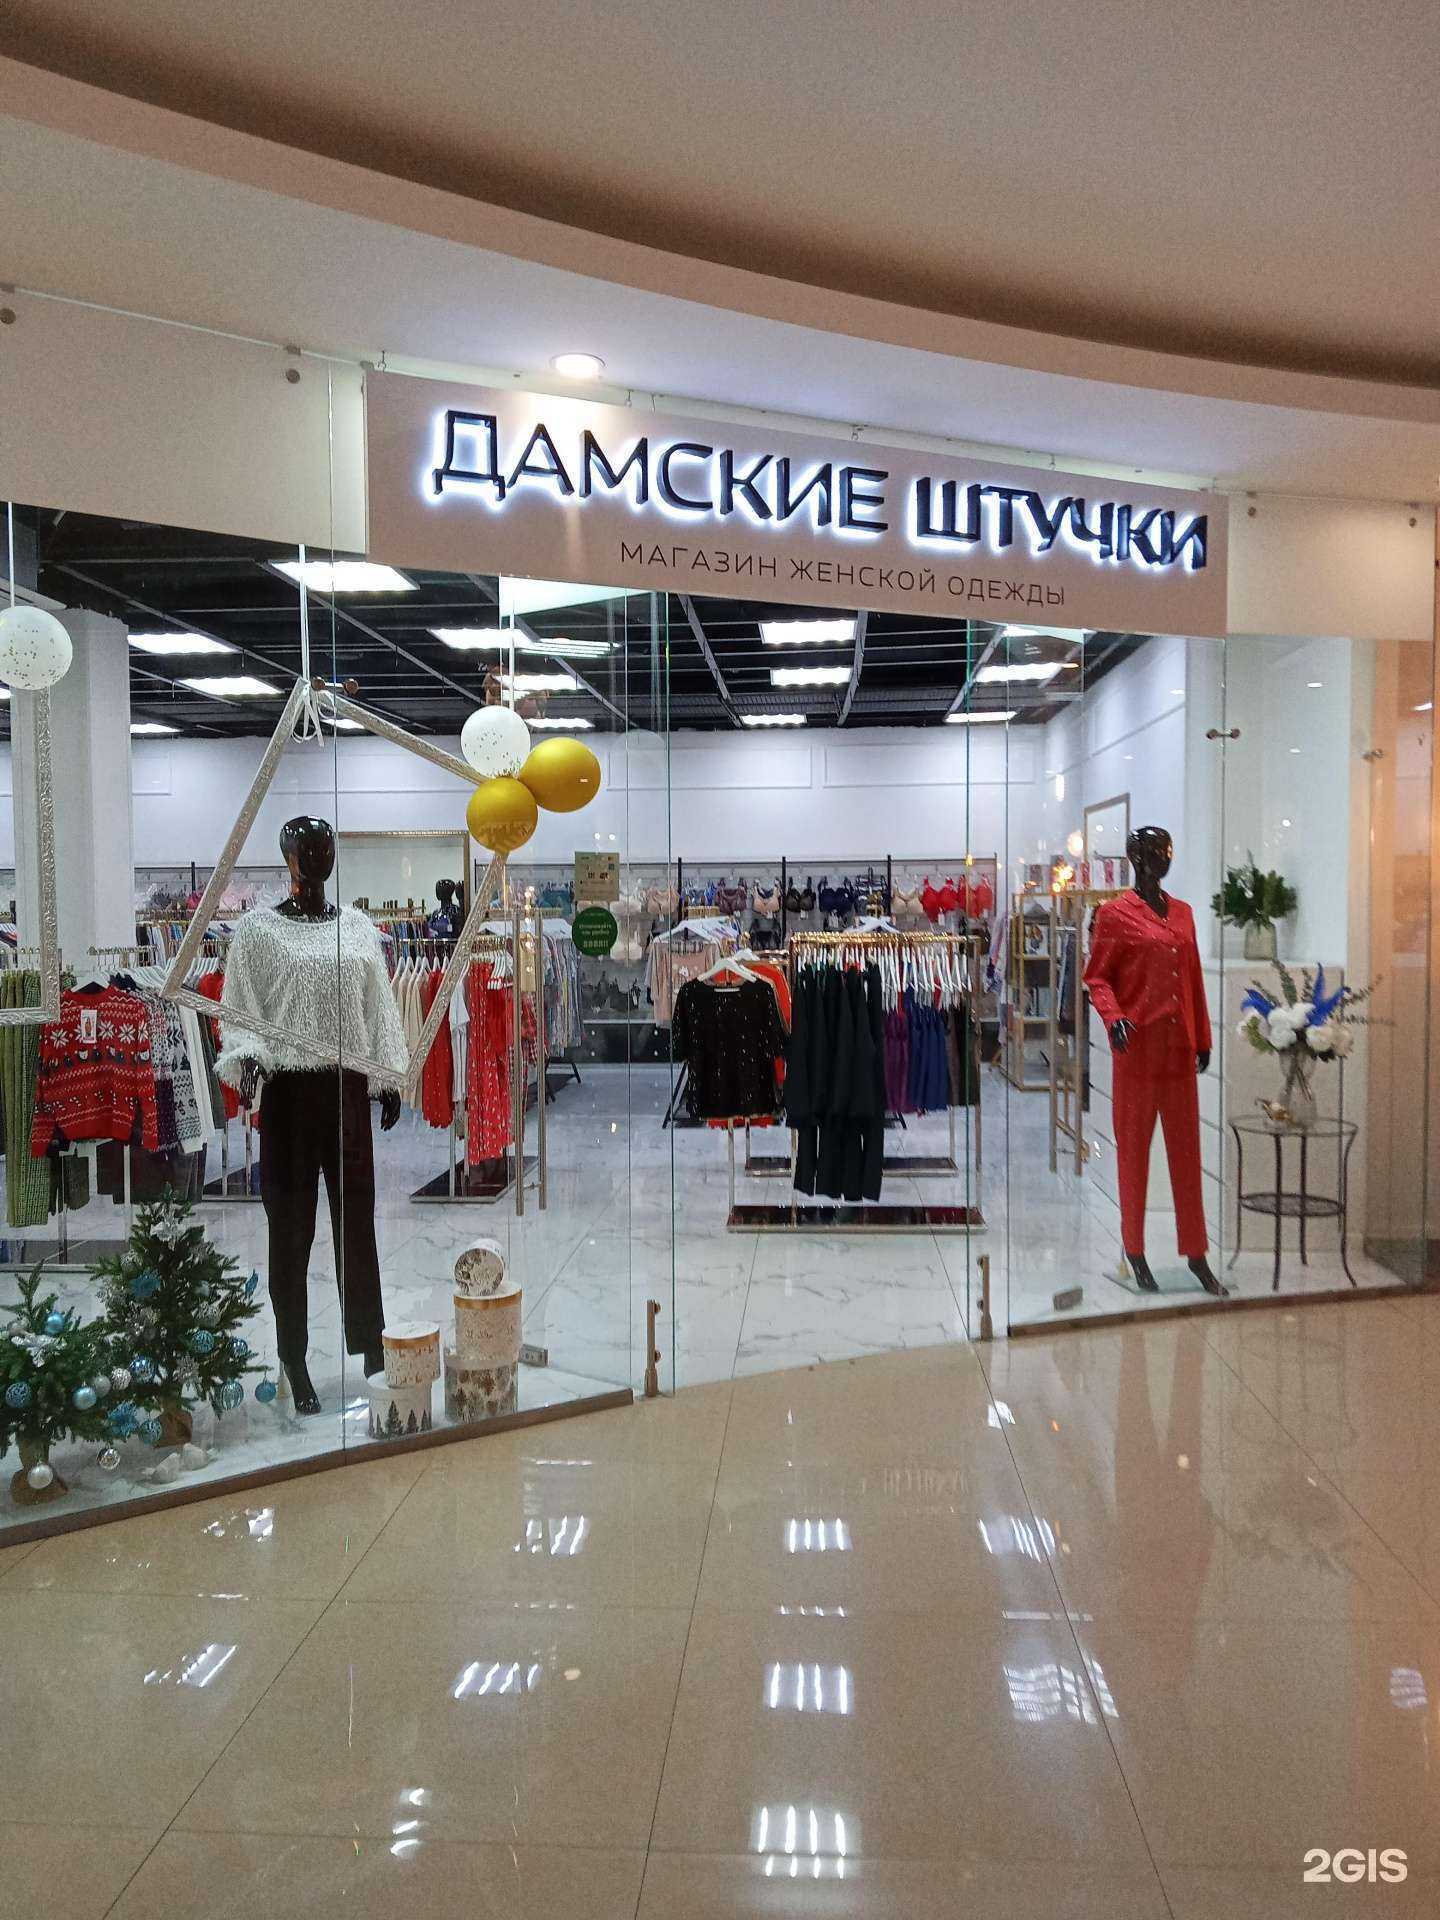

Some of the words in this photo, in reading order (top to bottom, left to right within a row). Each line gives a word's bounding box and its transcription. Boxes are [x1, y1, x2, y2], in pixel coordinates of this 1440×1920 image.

[432, 409, 889, 533] ДАМСКИЕ
[915, 476, 1209, 570] ШТУЧКИ
[620, 541, 777, 578] МАГАЗИН
[790, 558, 936, 594] ЖЕНСКОЙ
[947, 575, 1065, 607] ОДЕЖДЫ
